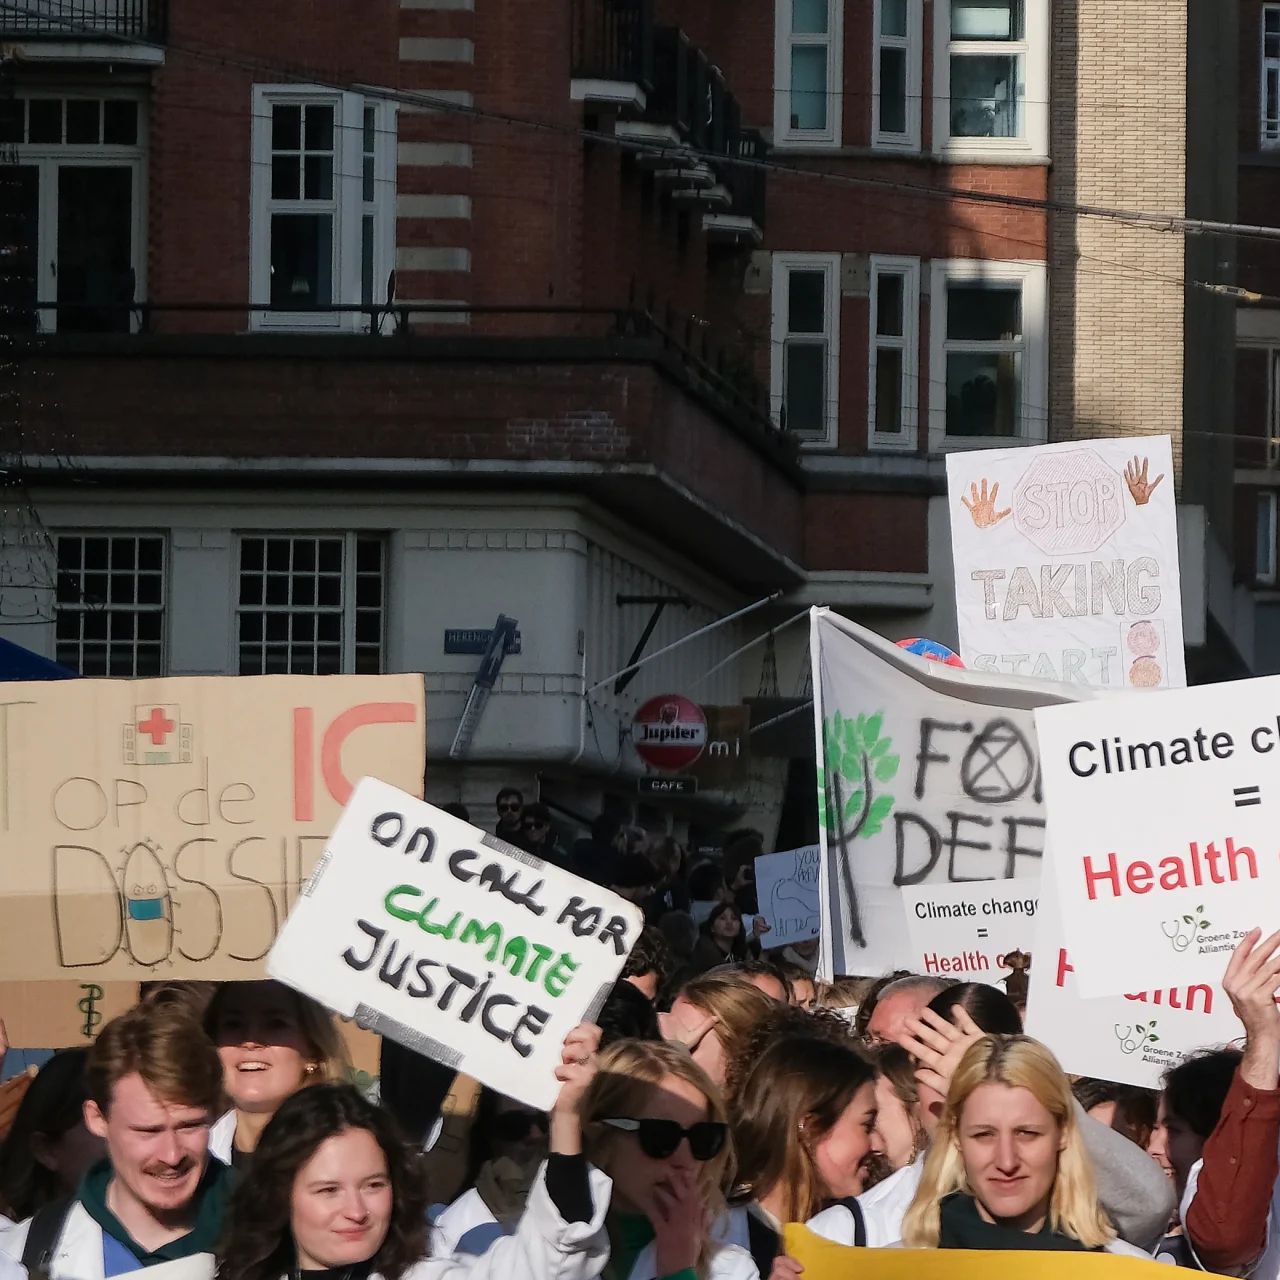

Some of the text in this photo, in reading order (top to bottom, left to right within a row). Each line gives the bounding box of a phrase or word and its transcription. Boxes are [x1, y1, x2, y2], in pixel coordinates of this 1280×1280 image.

[1021, 477, 1118, 531] STOP
[970, 556, 1161, 621] TAKING
[972, 645, 1118, 686] START
[641, 722, 700, 743] Jupiler
[1068, 725, 1235, 778] Climate
[52, 701, 418, 831] OP de IC
[651, 780, 686, 791] CAFE
[1232, 785, 1262, 808] =
[1082, 836, 1259, 901] Health
[448, 848, 548, 917] CALL
[556, 895, 629, 956] FOR
[914, 900, 977, 919] Climate
[383, 883, 582, 998] CLIMATE
[976, 927, 989, 938] =
[1195, 933, 1231, 945] Groene
[923, 949, 990, 973] Health
[1198, 943, 1237, 955] Alliantie
[1142, 1044, 1176, 1059] Groene
